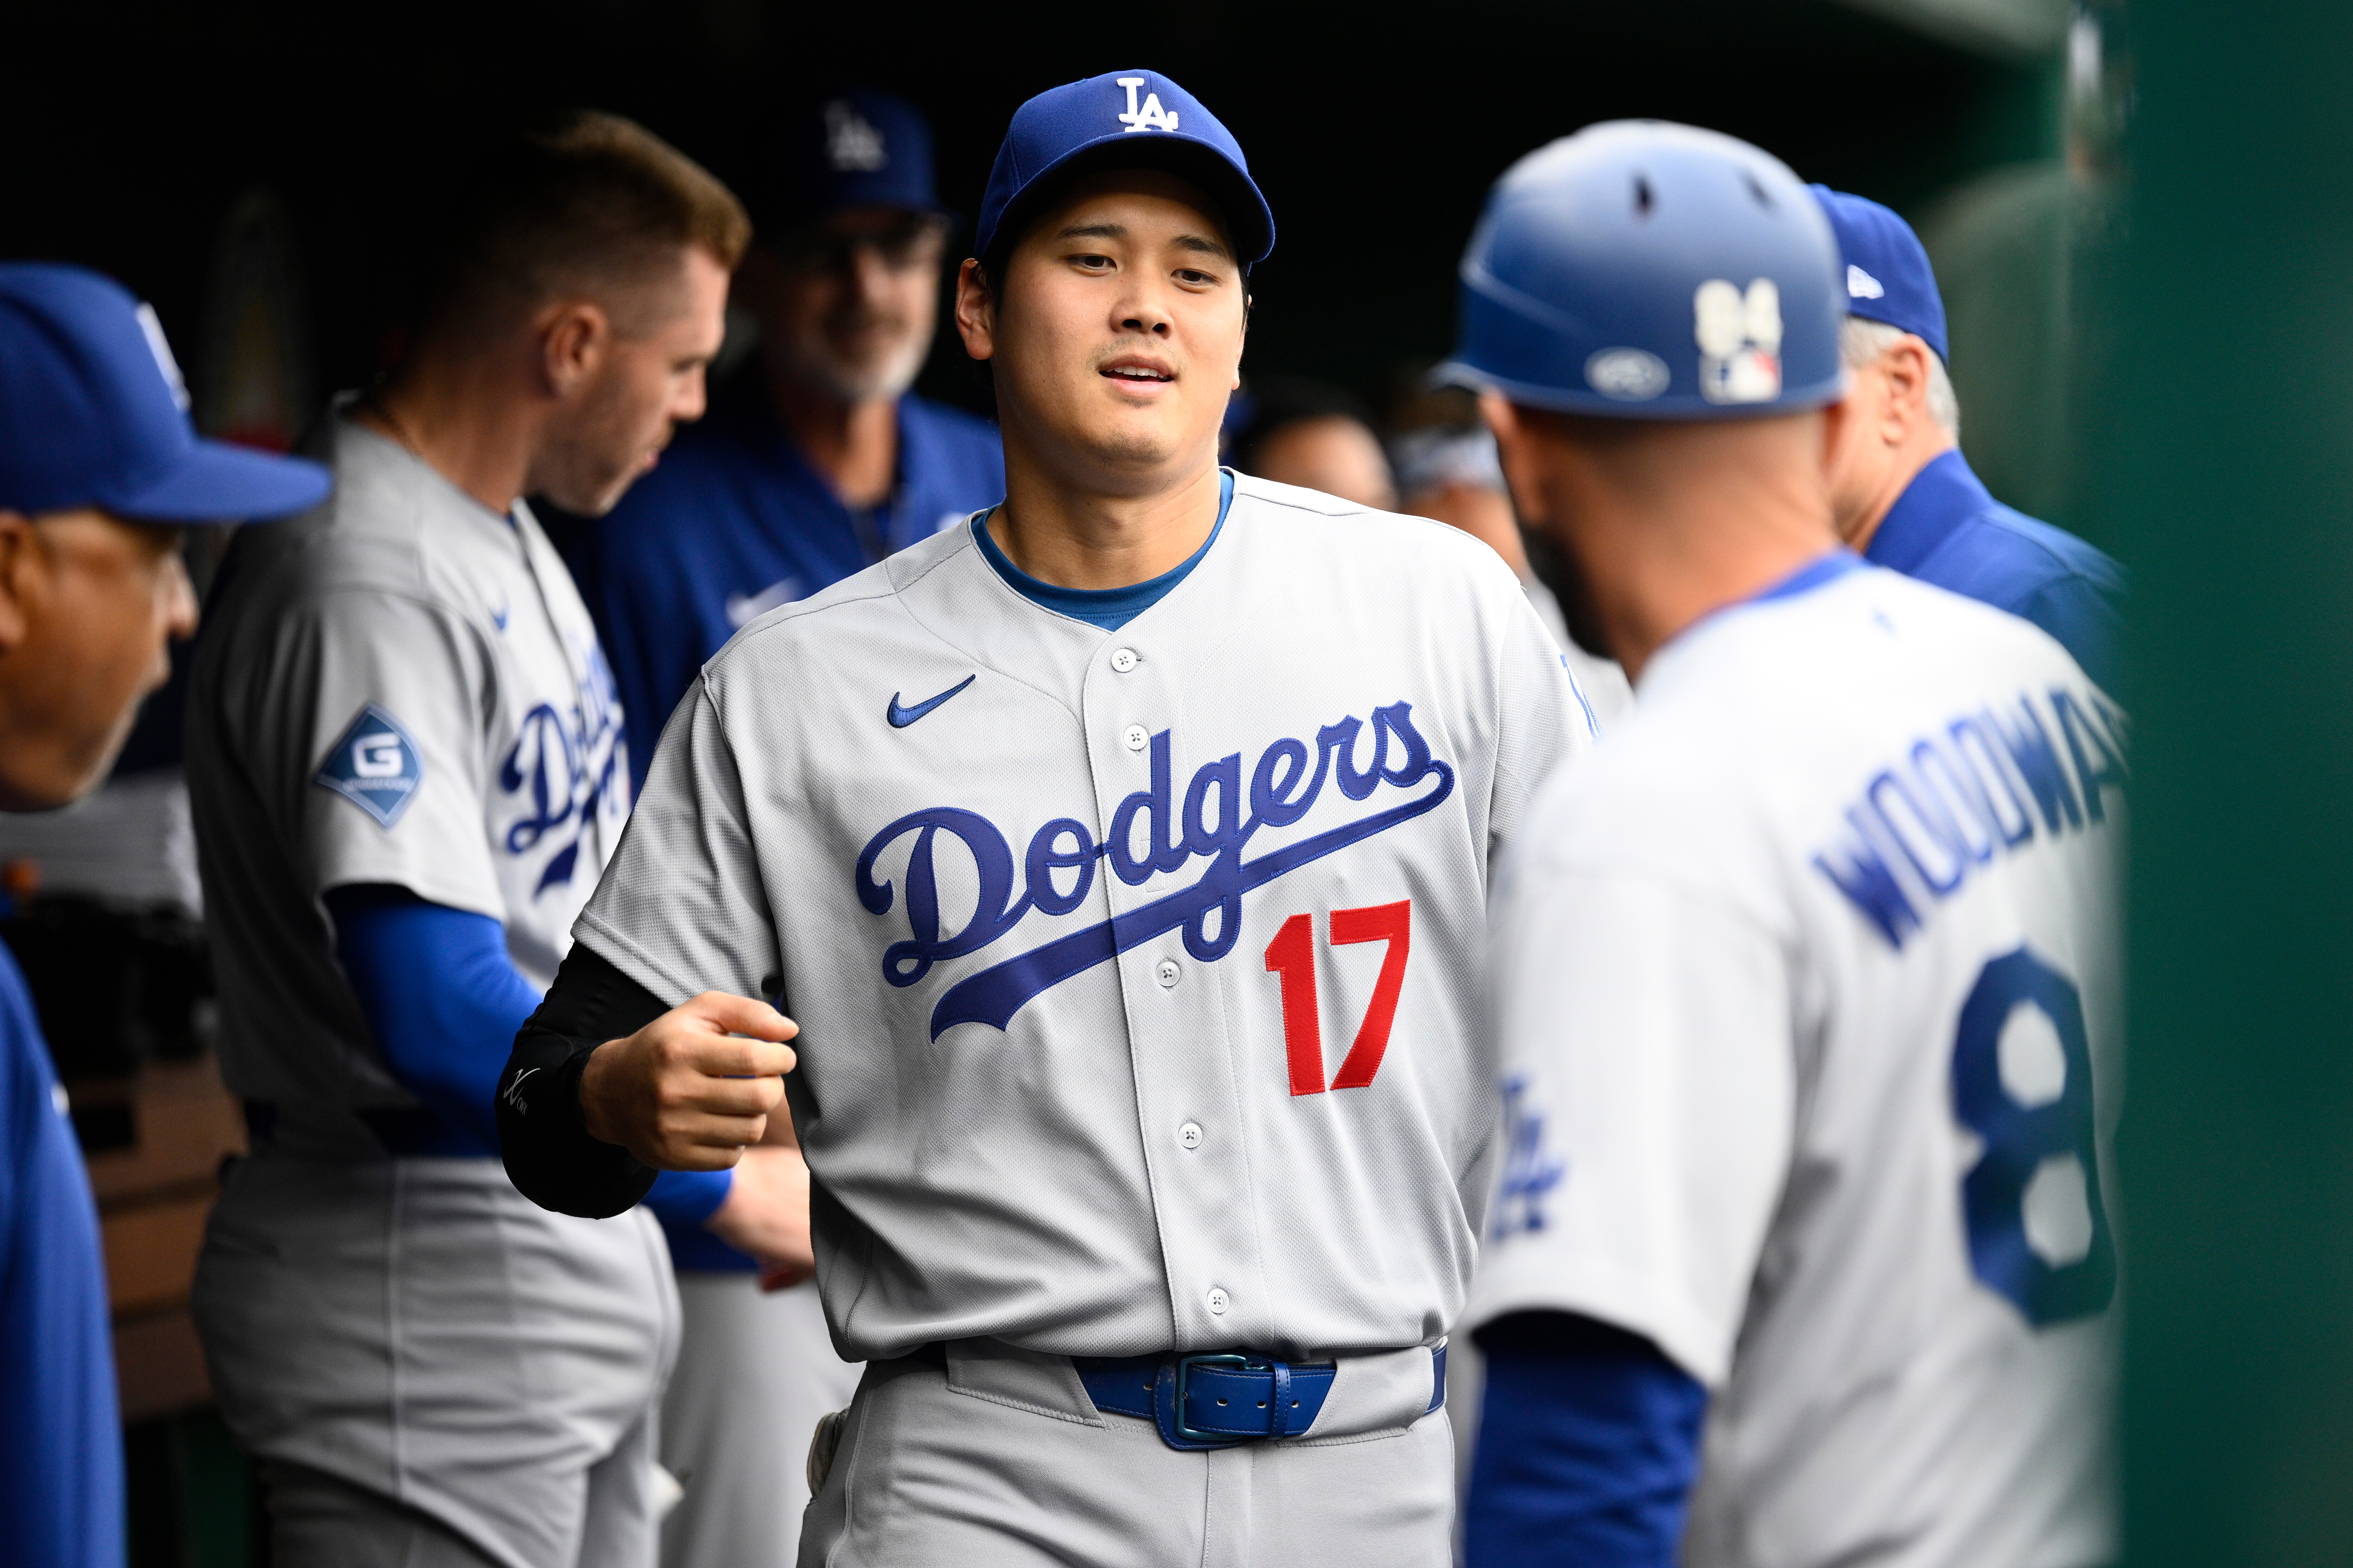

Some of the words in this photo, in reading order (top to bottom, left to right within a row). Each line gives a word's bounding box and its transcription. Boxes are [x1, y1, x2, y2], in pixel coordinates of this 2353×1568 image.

[1117, 77, 1179, 132] LA
[855, 700, 1455, 1044] Dodgers
[1811, 686, 2128, 954] WOODWA
[1264, 899, 1411, 1097] 17
